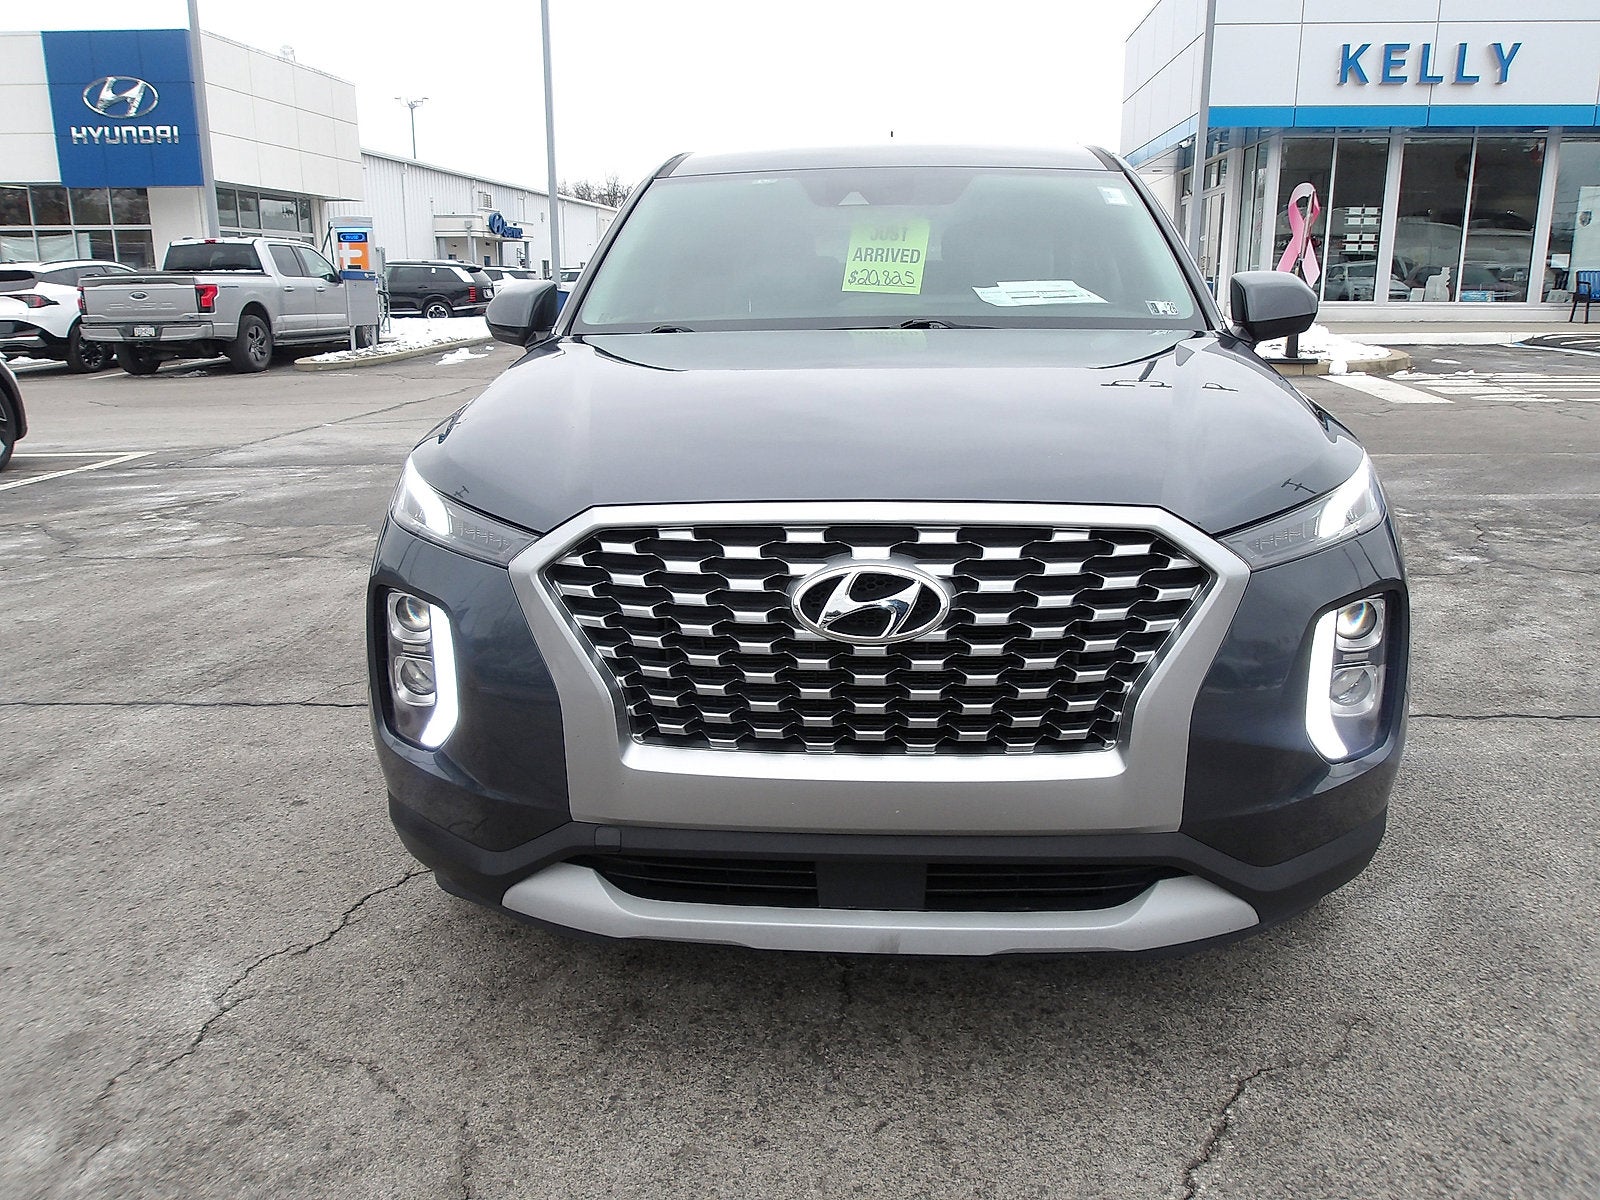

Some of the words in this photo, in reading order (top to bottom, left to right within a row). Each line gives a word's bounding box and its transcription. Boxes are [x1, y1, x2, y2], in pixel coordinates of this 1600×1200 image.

[1337, 42, 1522, 86] KELLY
[70, 125, 180, 144] HYUNDAI
[852, 247, 921, 263] ARRIVED
[848, 268, 915, 286] $20,825
